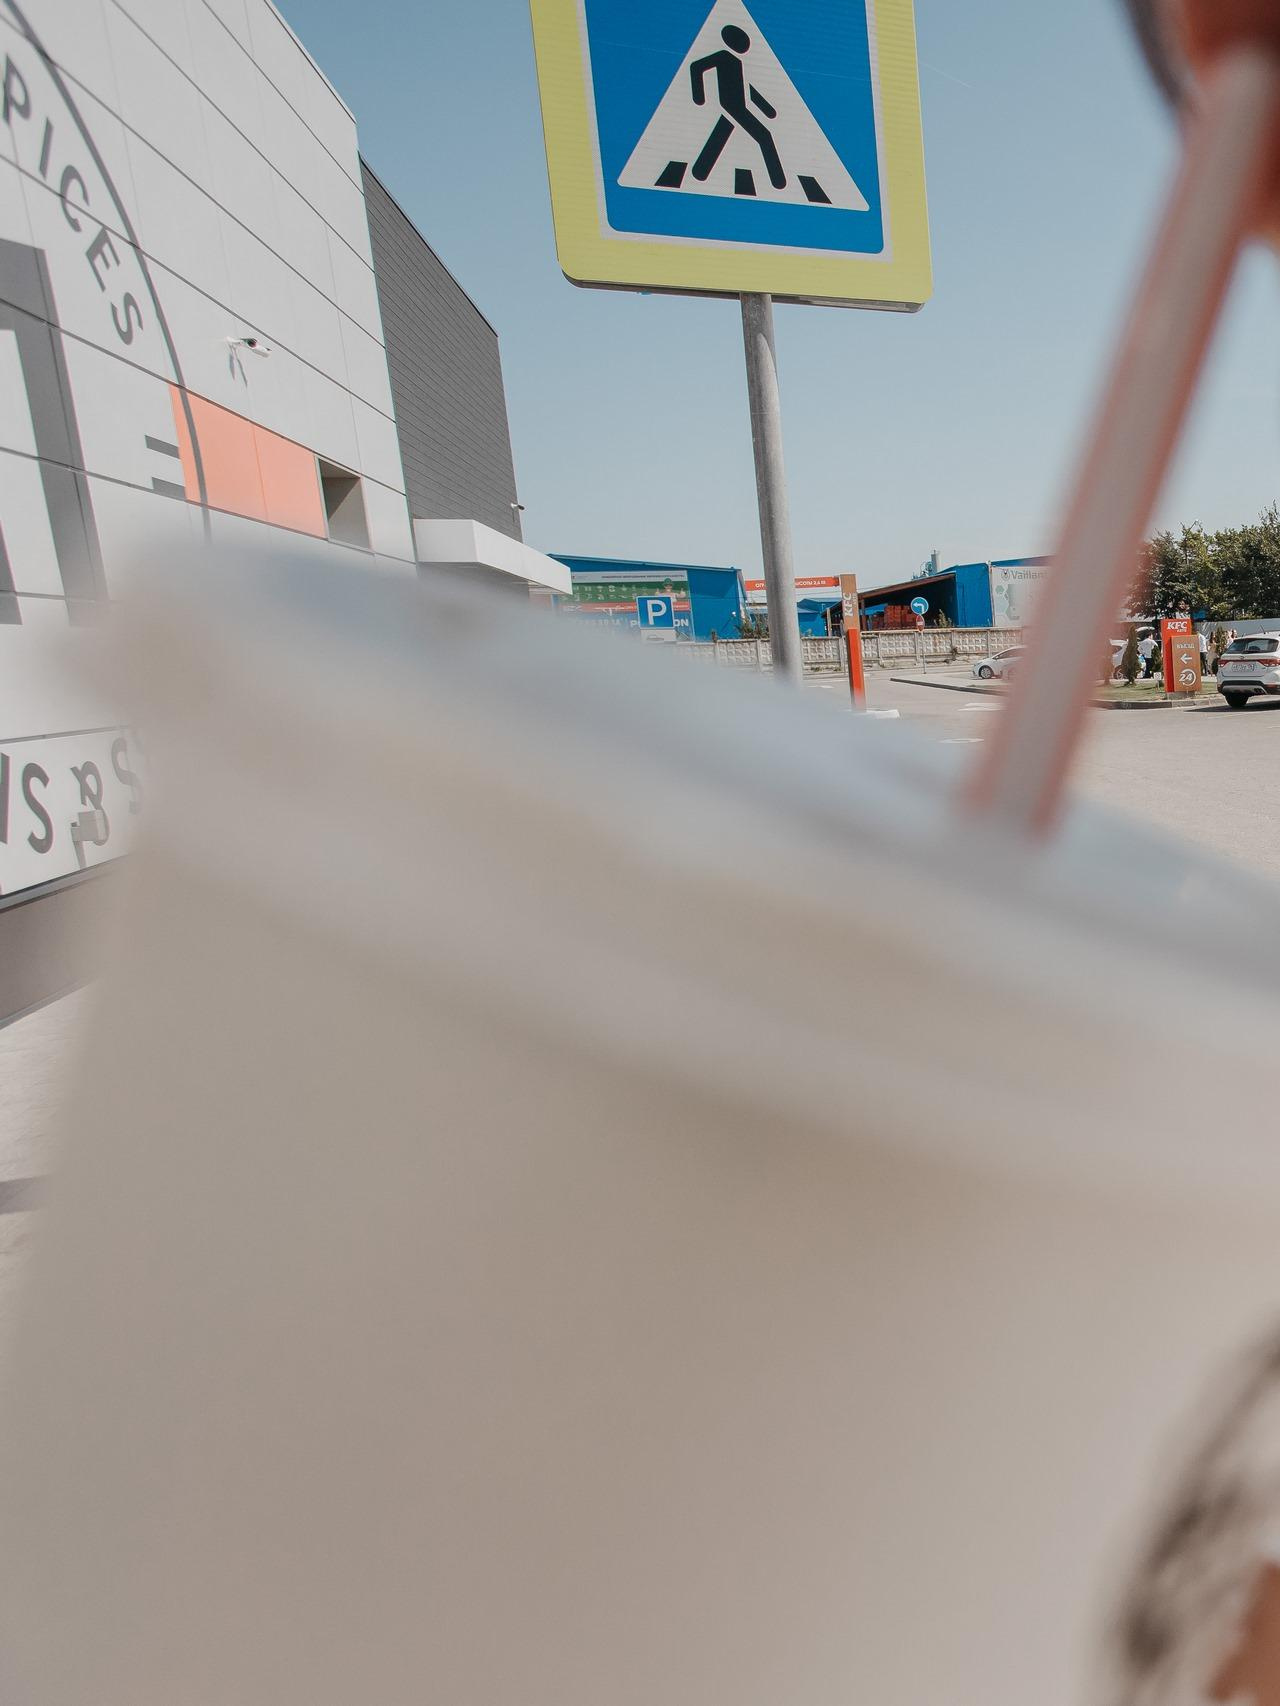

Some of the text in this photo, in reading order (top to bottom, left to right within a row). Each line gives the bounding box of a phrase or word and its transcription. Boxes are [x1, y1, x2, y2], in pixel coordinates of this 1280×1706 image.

[646, 600, 667, 625] P
[843, 592, 853, 617] KFC
[1167, 621, 1188, 630] KFC
[1179, 673, 1193, 682] 24
